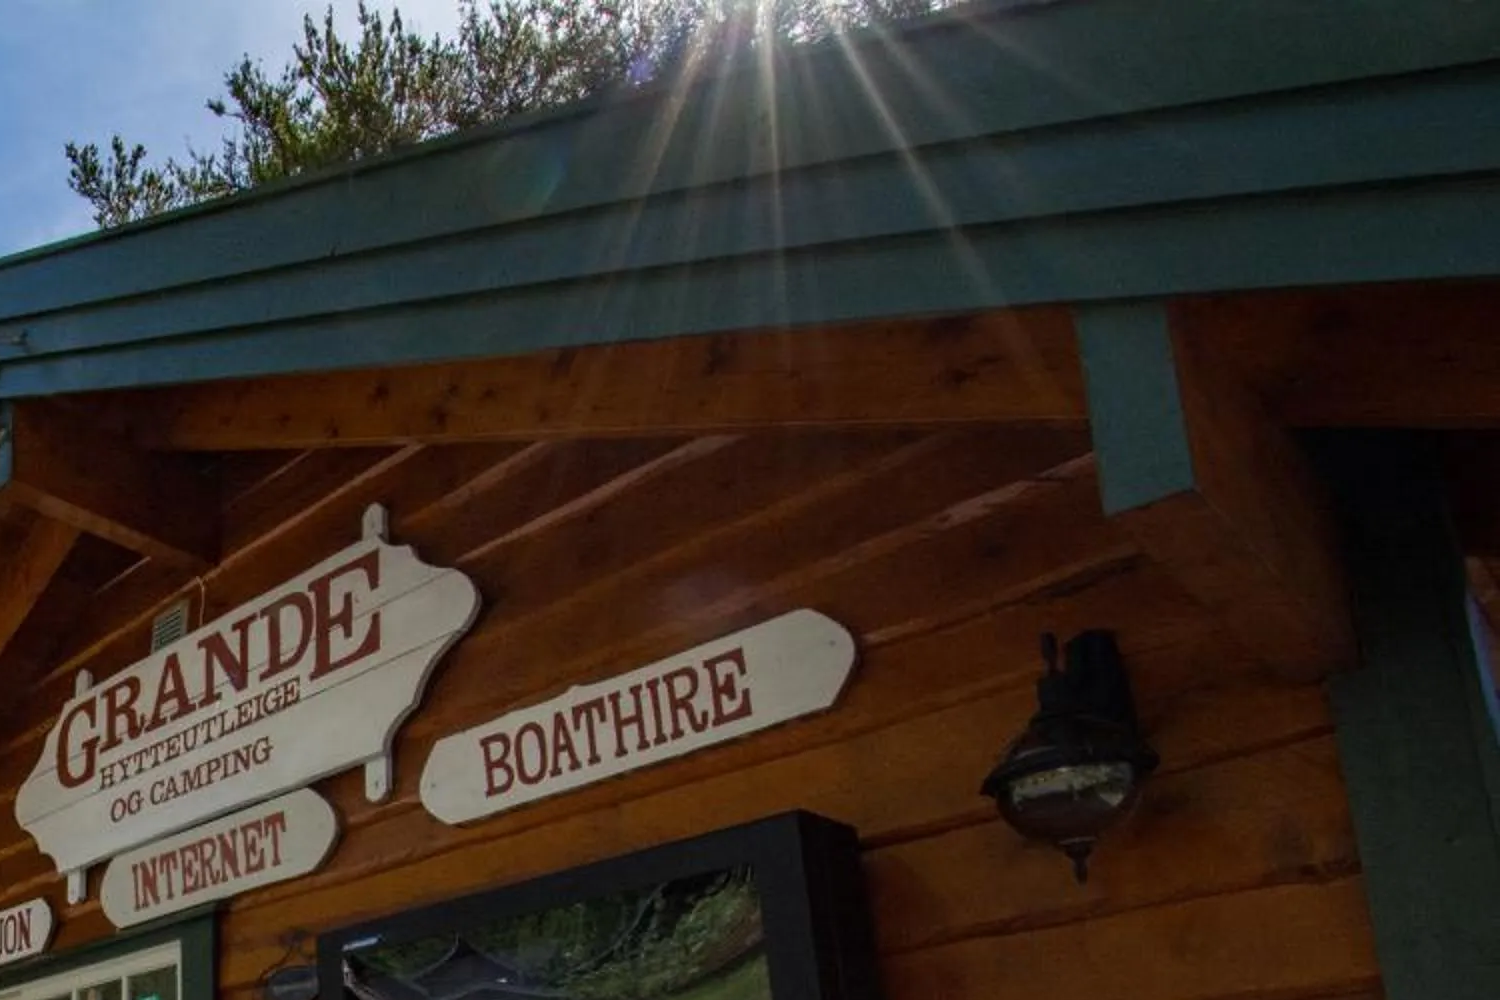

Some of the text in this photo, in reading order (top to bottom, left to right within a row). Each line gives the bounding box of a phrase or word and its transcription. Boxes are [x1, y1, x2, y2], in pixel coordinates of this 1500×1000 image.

[56, 548, 381, 789] GRANDE
[480, 647, 753, 798] BOATHIRE
[100, 678, 301, 790] HYTTEUTLEIGE
[110, 736, 273, 823] OG CAMPING
[131, 811, 286, 912] INTERNET
